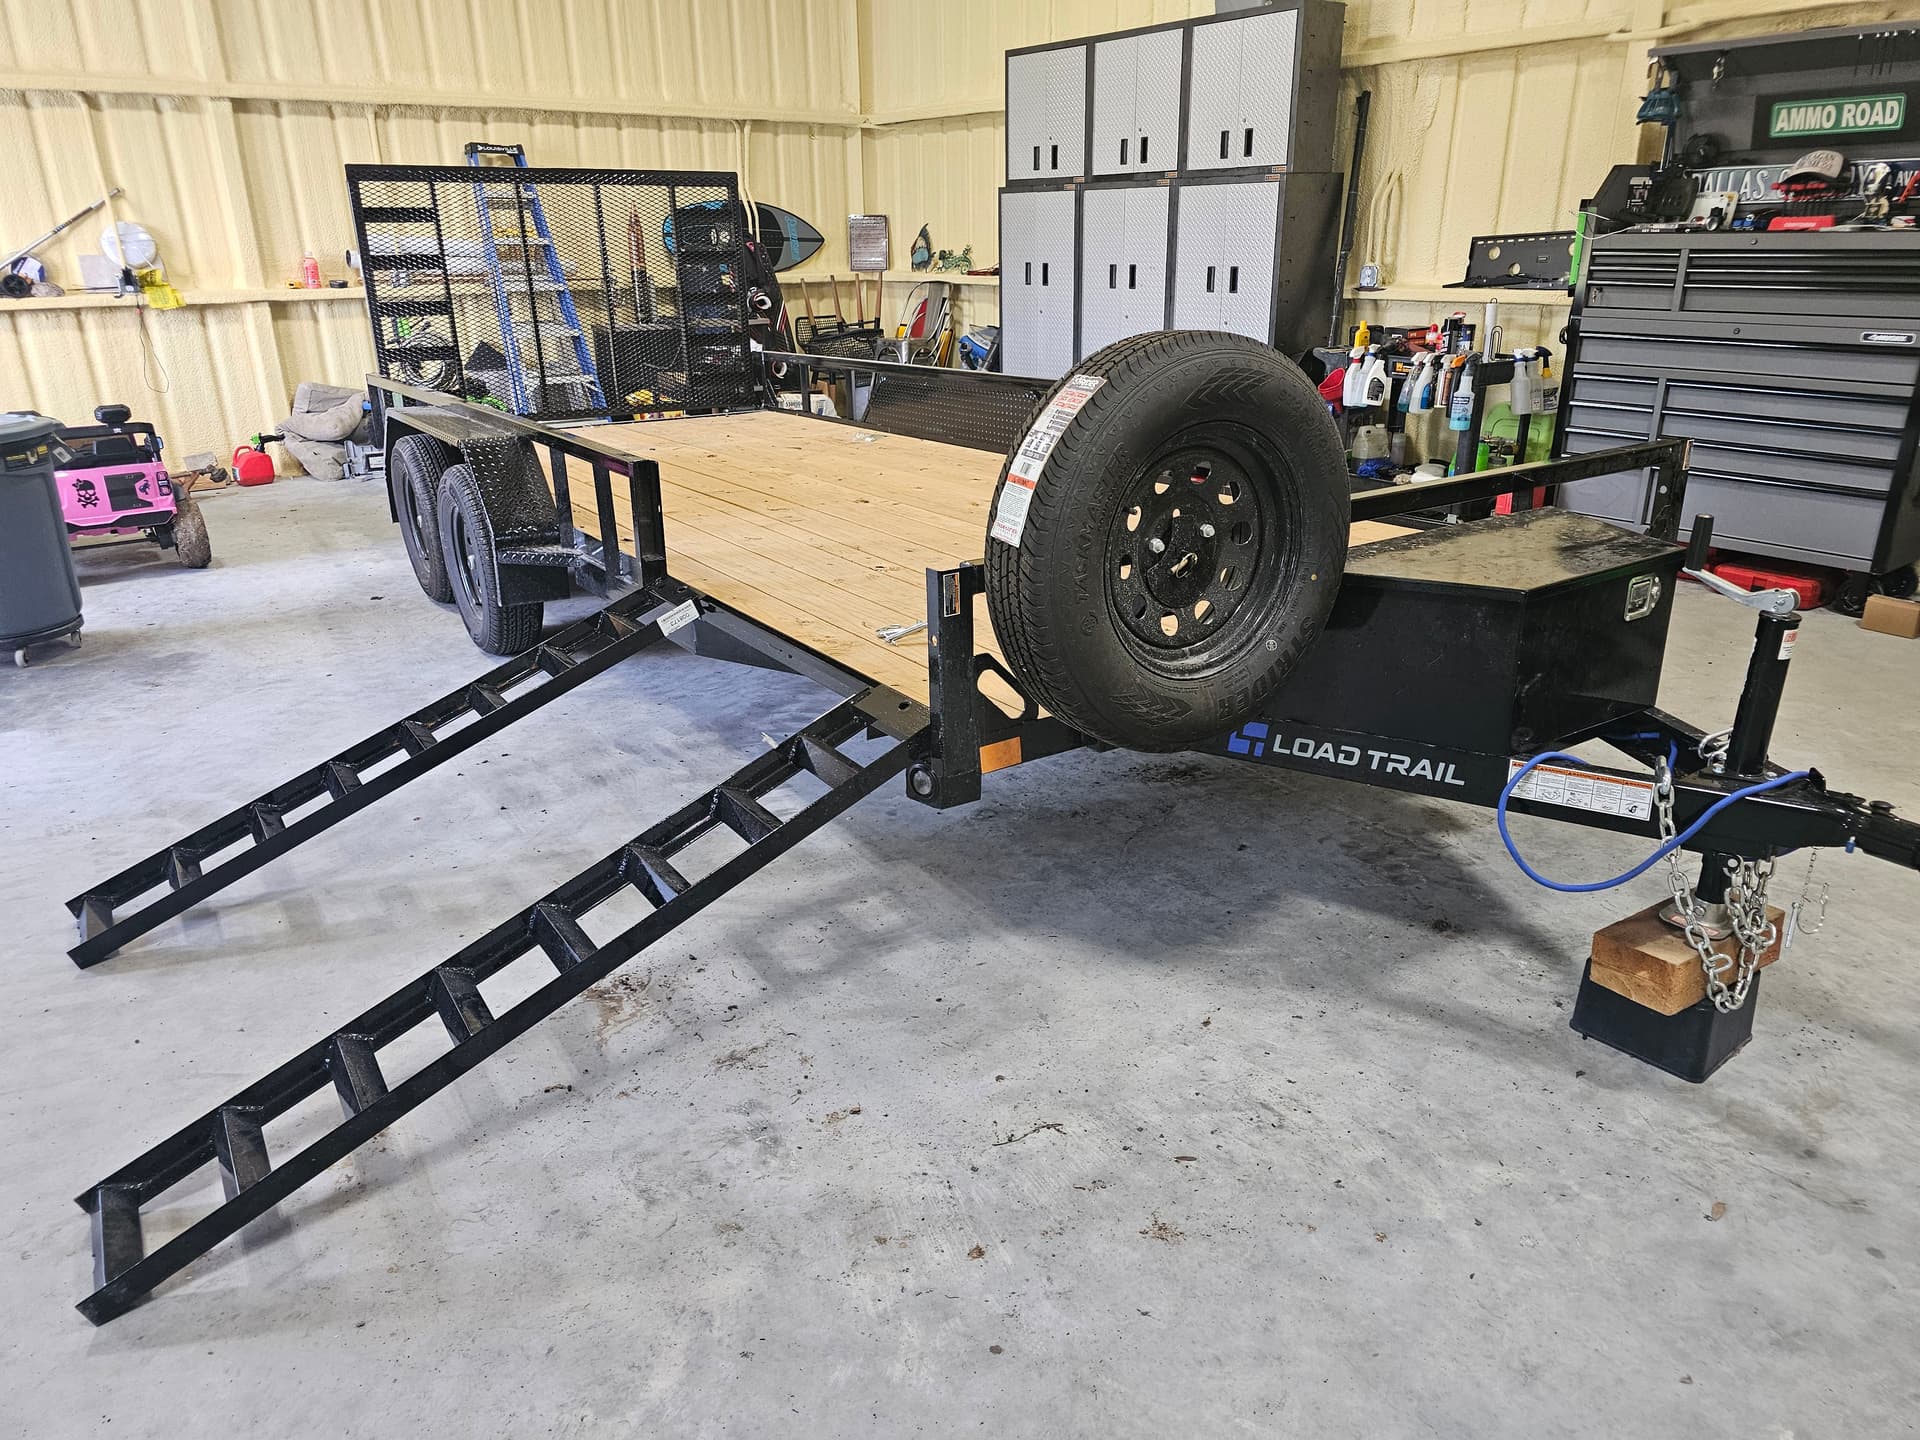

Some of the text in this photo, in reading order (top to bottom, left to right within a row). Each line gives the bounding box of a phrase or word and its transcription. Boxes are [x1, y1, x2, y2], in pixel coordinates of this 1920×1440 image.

[1775, 100, 1899, 131] AMMO ROAD
[1273, 734, 1465, 786] LOAD TRAIL
